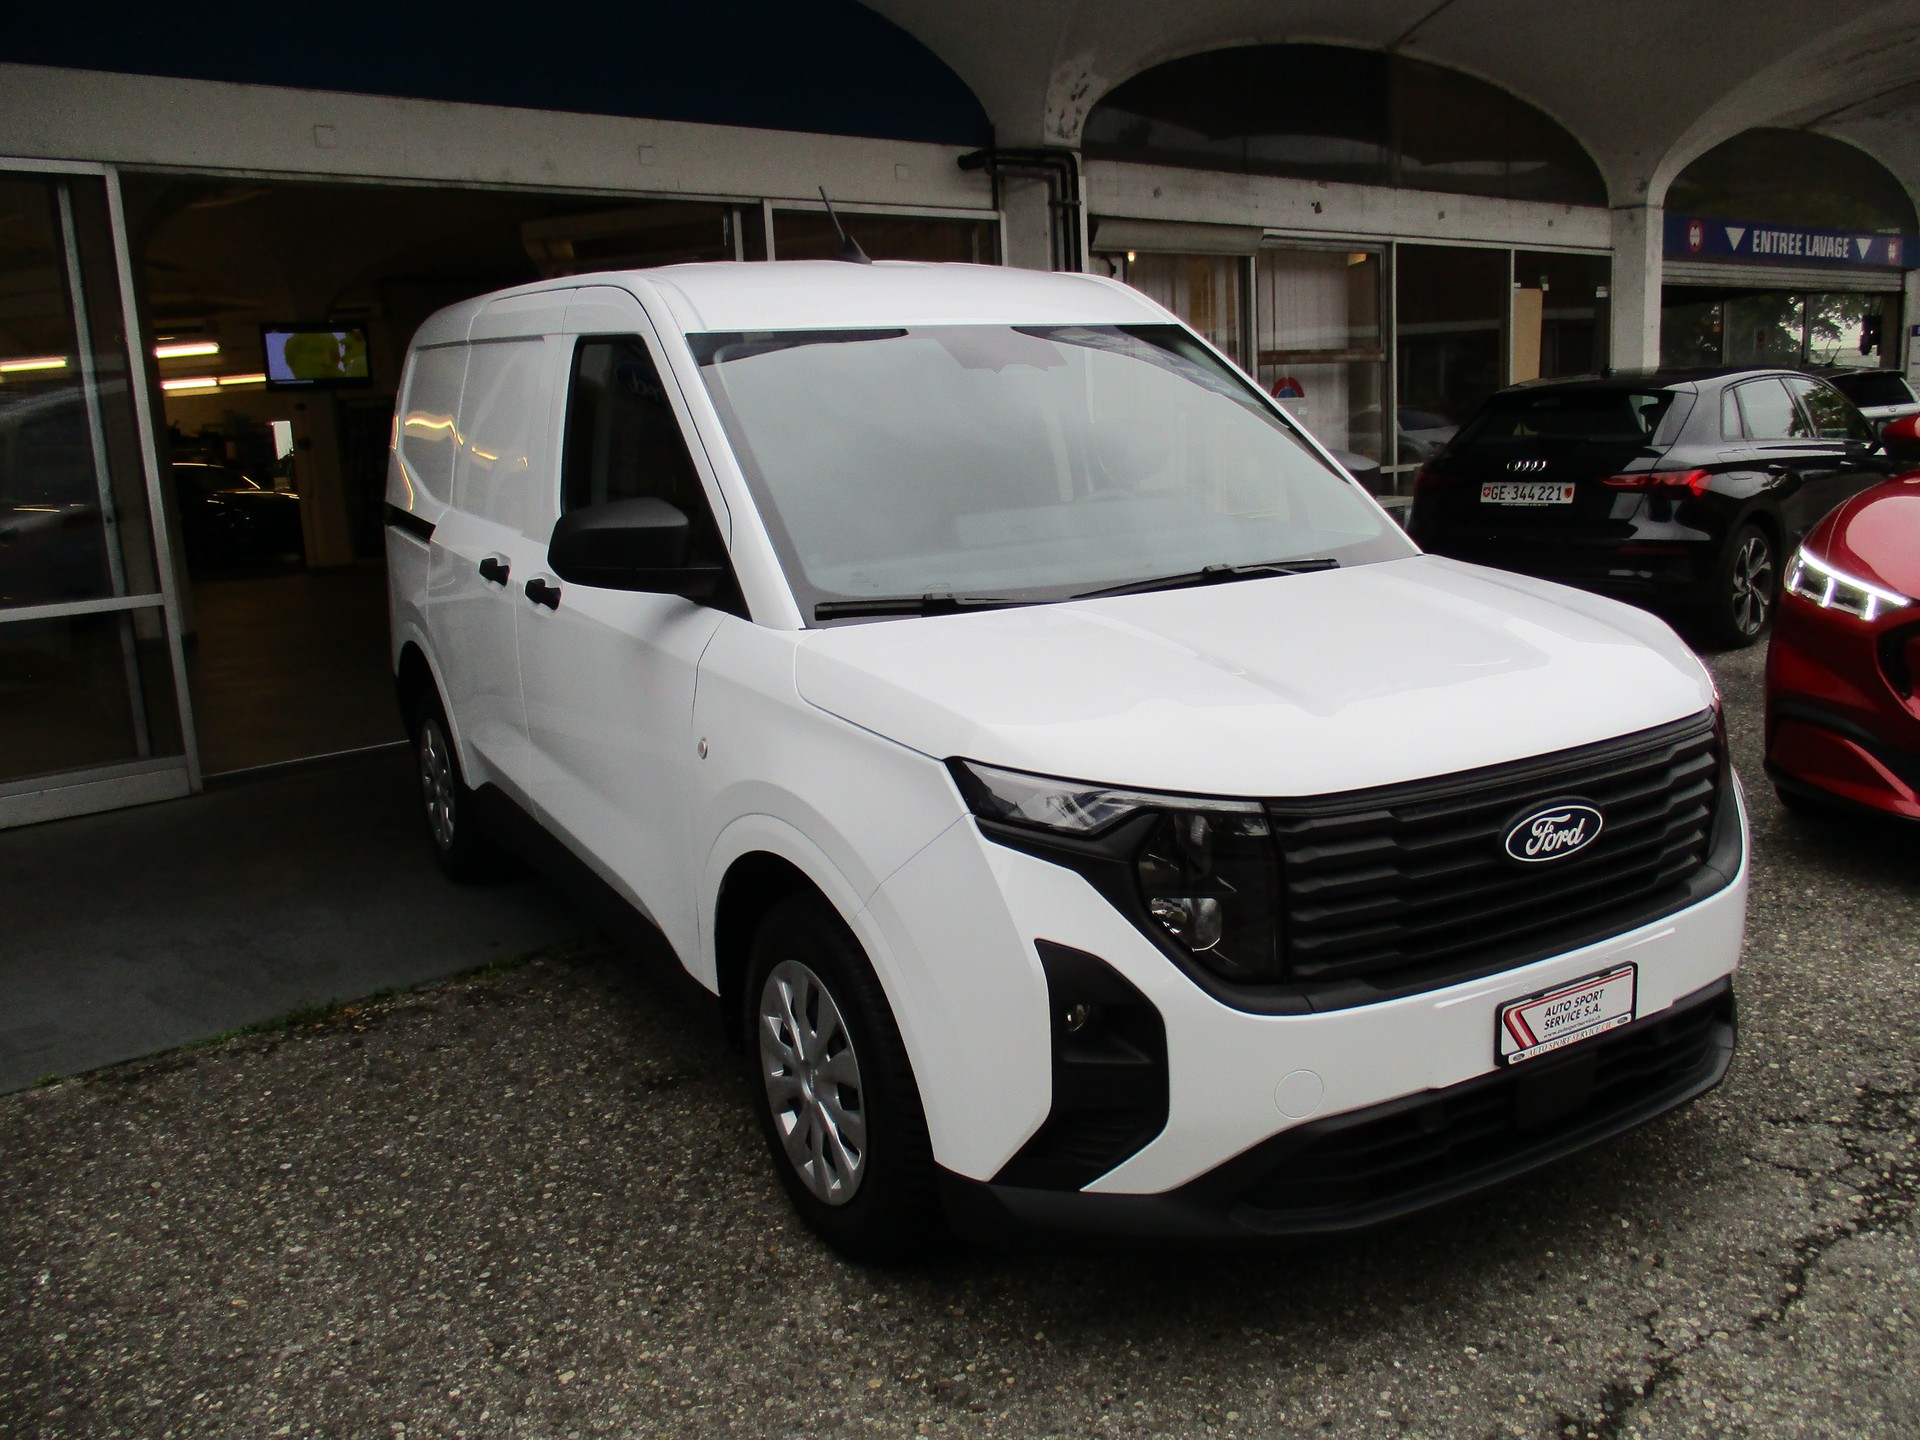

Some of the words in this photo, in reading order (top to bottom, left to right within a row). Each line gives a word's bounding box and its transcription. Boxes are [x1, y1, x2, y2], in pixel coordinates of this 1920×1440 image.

[1752, 230, 1802, 256] ENTREE
[1805, 234, 1849, 259] LAVAGE
[1525, 813, 1586, 856] Ford
[1544, 1000, 1571, 1018] AUTO
[1574, 989, 1605, 1006] SPORT
[1544, 1009, 1581, 1030] SERVICE
[1584, 1003, 1602, 1016] S.A.
[1528, 1044, 1548, 1057] AUTO
[1549, 1036, 1572, 1049] SPORT
